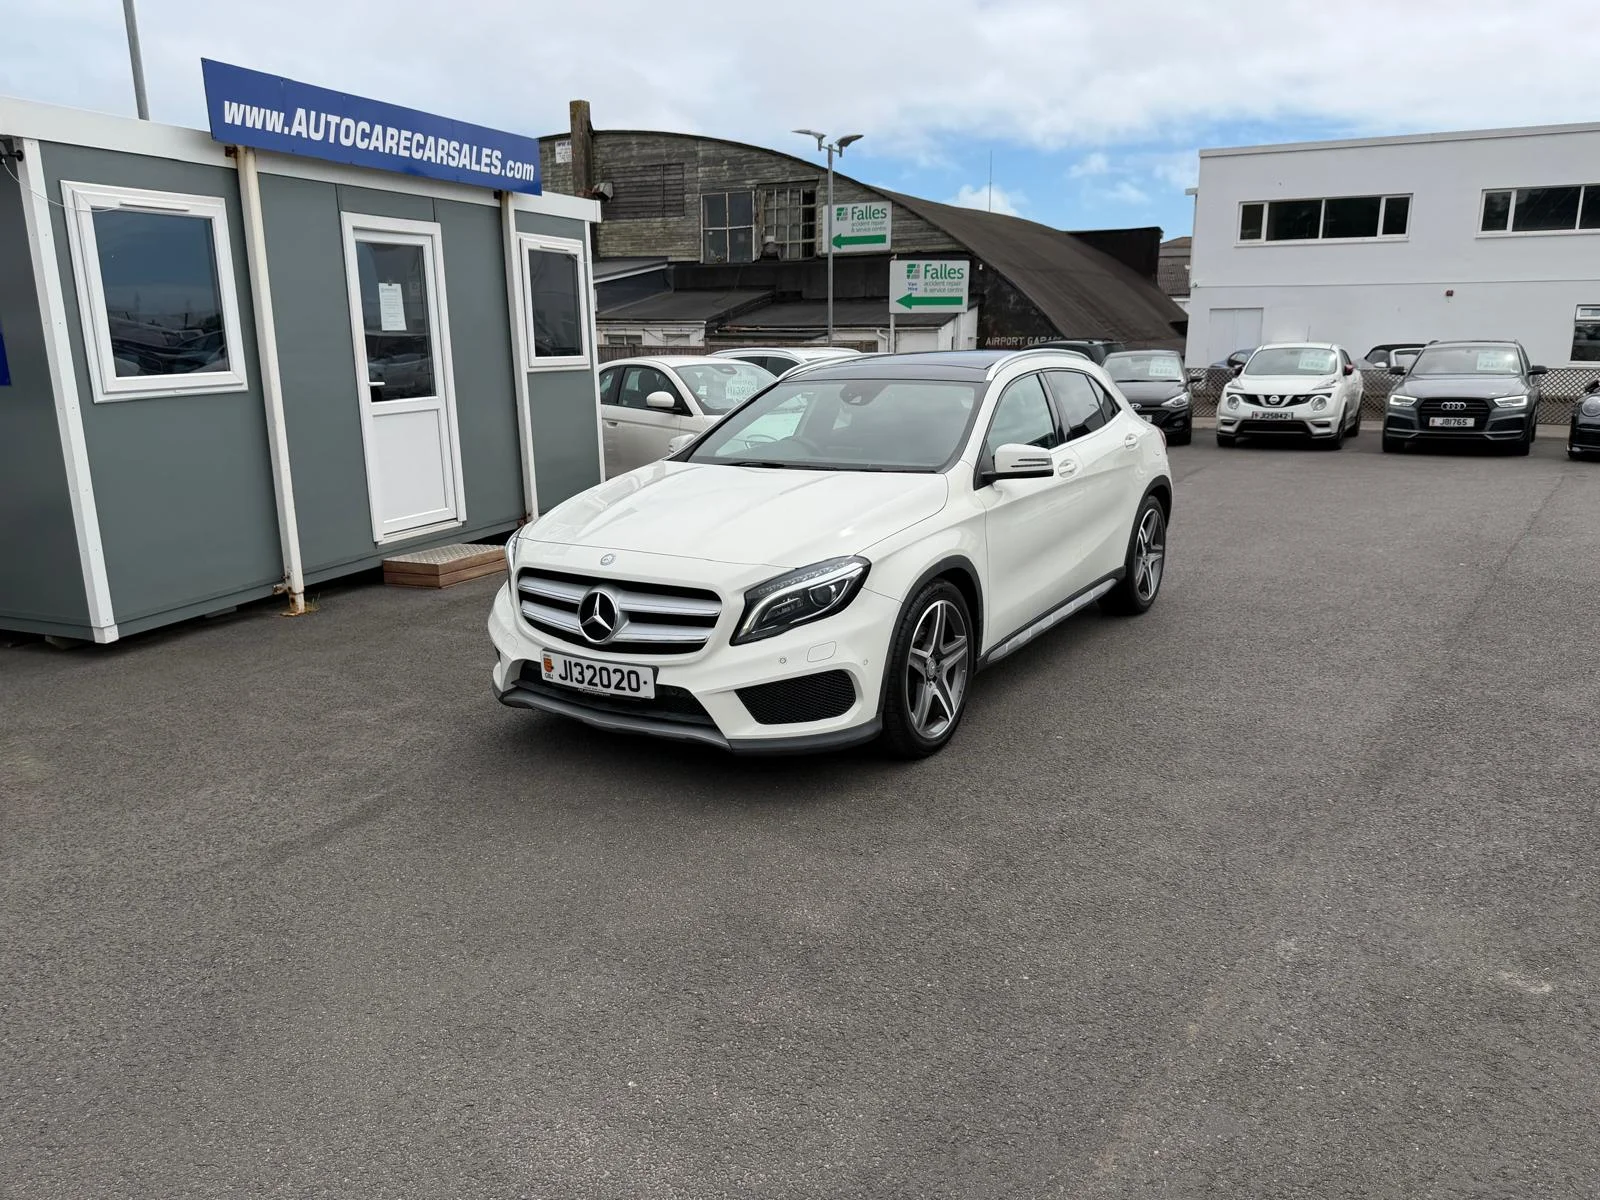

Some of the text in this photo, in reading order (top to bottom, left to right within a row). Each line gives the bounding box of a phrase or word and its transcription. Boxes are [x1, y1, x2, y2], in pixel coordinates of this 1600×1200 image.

[223, 100, 535, 182] www.AUTOCARECARSALES.com
[851, 205, 887, 221] Falles
[924, 263, 964, 280] Falles
[985, 337, 1024, 346] AIRPORT
